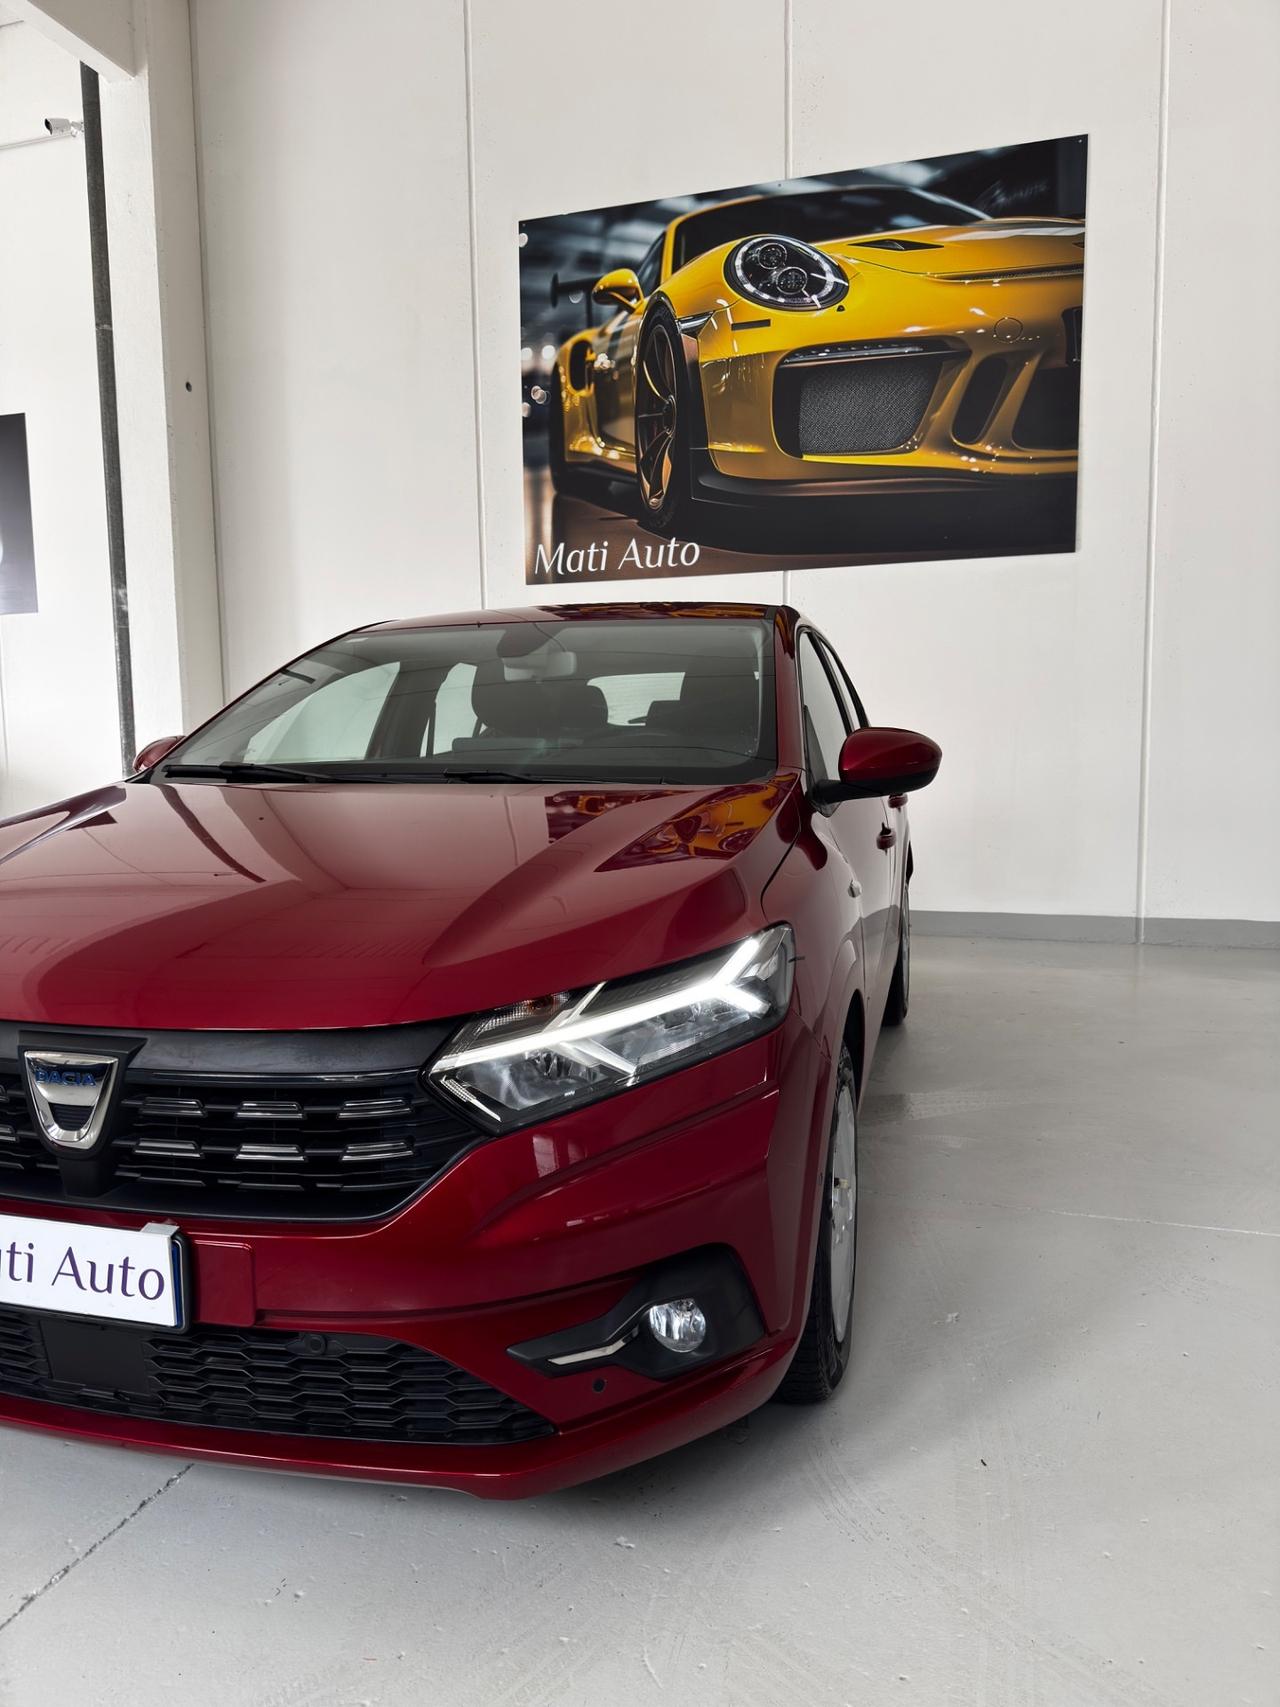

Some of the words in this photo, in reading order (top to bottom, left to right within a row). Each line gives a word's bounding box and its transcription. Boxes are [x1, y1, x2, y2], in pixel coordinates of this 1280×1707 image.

[535, 540, 609, 575] Mati
[617, 537, 700, 570] Auto
[35, 1070, 97, 1087] DACIA
[0, 1242, 34, 1283] ti
[51, 1246, 165, 1300] Auto
